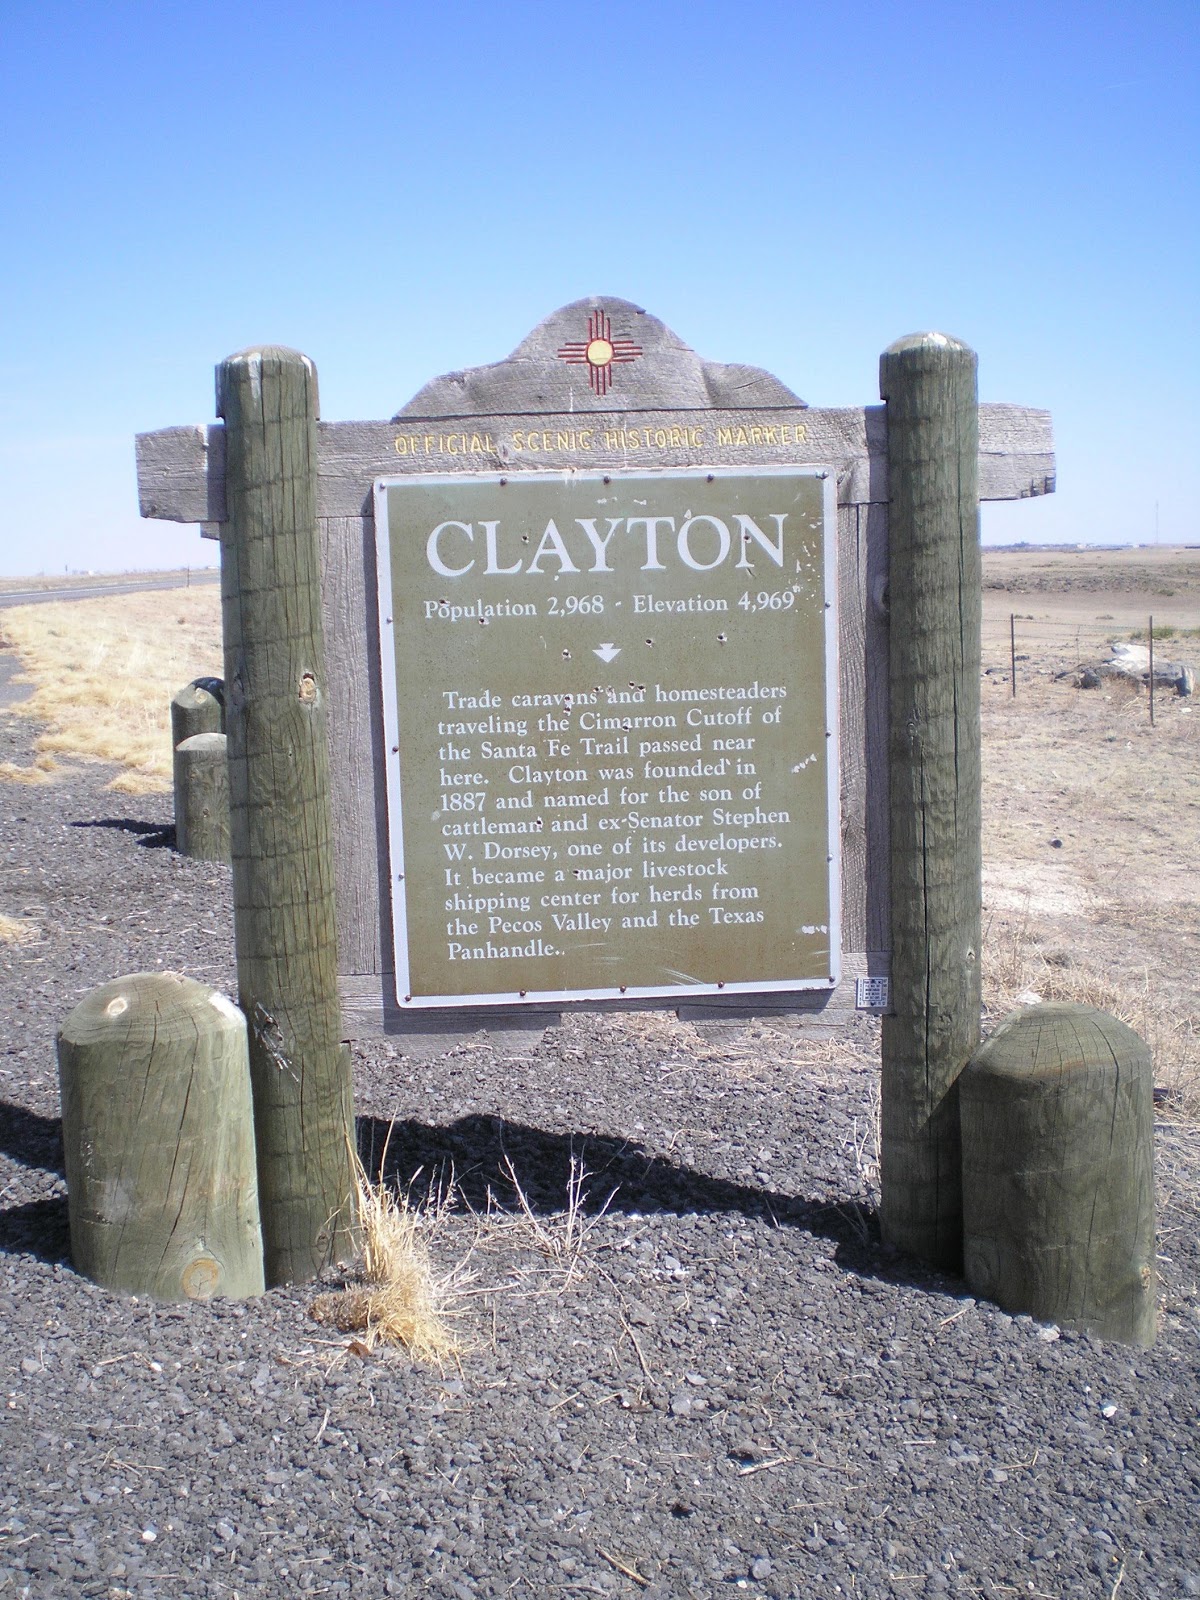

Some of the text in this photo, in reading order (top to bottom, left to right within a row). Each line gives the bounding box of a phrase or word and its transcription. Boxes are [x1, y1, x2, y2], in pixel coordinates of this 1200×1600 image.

[394, 424, 809, 455] OFFICIAL SCENIC HISTORIC MARKER
[425, 513, 788, 577] CLAYTON
[424, 599, 537, 622] Population
[547, 596, 605, 617] 2,968
[633, 594, 728, 614] Elevation
[737, 591, 794, 612] 4,969
[442, 682, 787, 709] Trade caravans and homesteaders
[438, 706, 782, 736] traveling the Cimarron Cutoff of
[438, 734, 756, 761] the Santa Fe Trail passed near
[439, 759, 756, 786] here. Clayton was founded in
[440, 782, 762, 811] 1887 and named for the son of
[441, 806, 791, 836] cattleman and ex-Senator Stephen
[444, 832, 782, 861] W. Dorsey, one of its developers.
[444, 858, 729, 886] It became a major livestock
[444, 881, 759, 912] shipping center for herds from
[446, 906, 764, 936] the Pecos Valley and the Texas
[448, 939, 560, 961] Panhandle.
